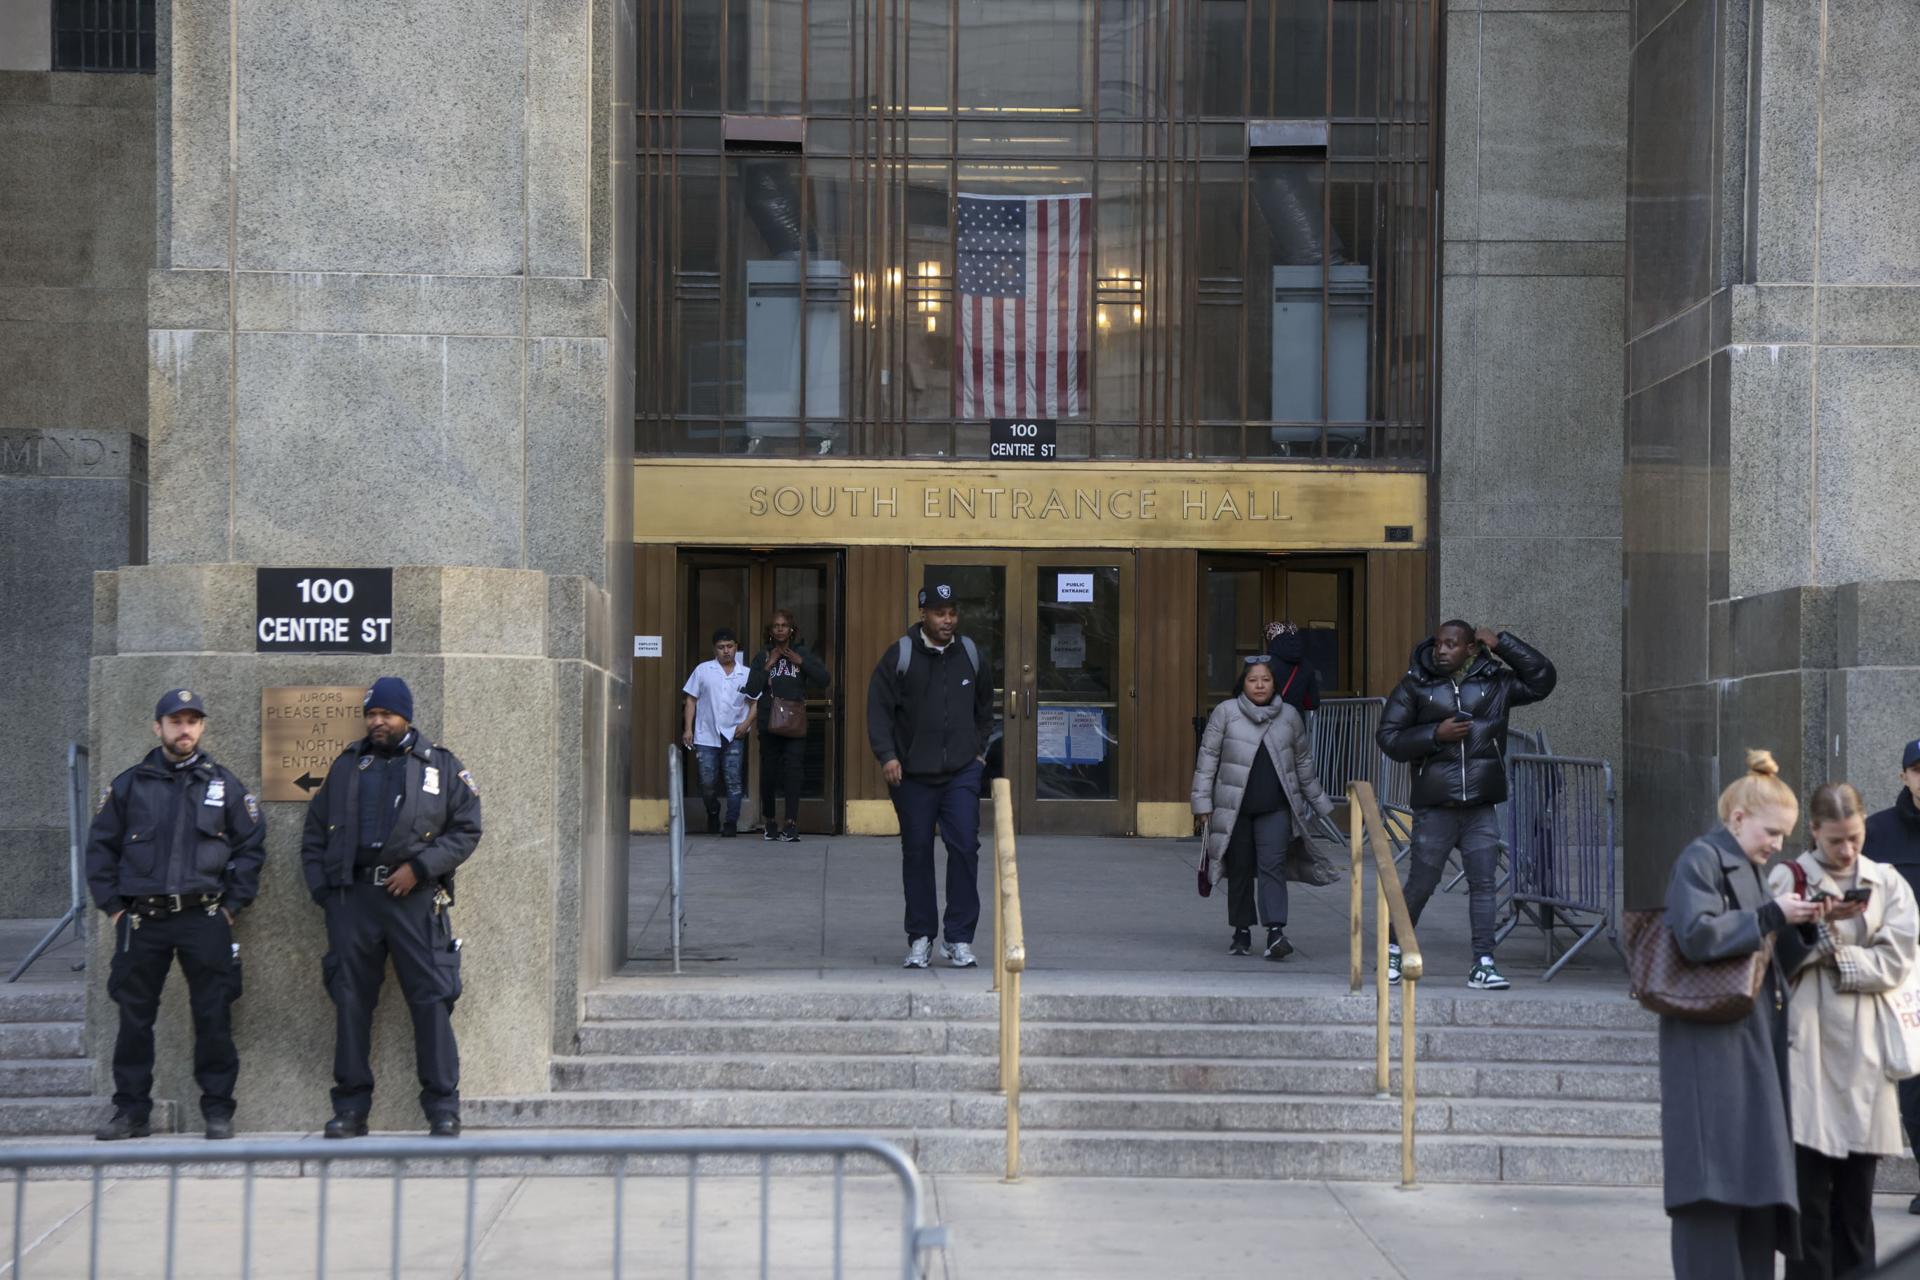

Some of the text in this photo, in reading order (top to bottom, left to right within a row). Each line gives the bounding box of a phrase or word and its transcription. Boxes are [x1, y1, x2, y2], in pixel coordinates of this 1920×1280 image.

[1010, 424, 1038, 437] 100
[991, 442, 1056, 457] CENTRE ST
[750, 486, 1293, 521] SOUTH ENTRANCE HALL
[296, 578, 355, 604] 100
[258, 617, 392, 643] CENTRE ST
[298, 692, 343, 703] JURORS
[266, 706, 361, 719] PLEASE ENTE
[311, 722, 329, 735] AT
[296, 739, 344, 752] NORTH
